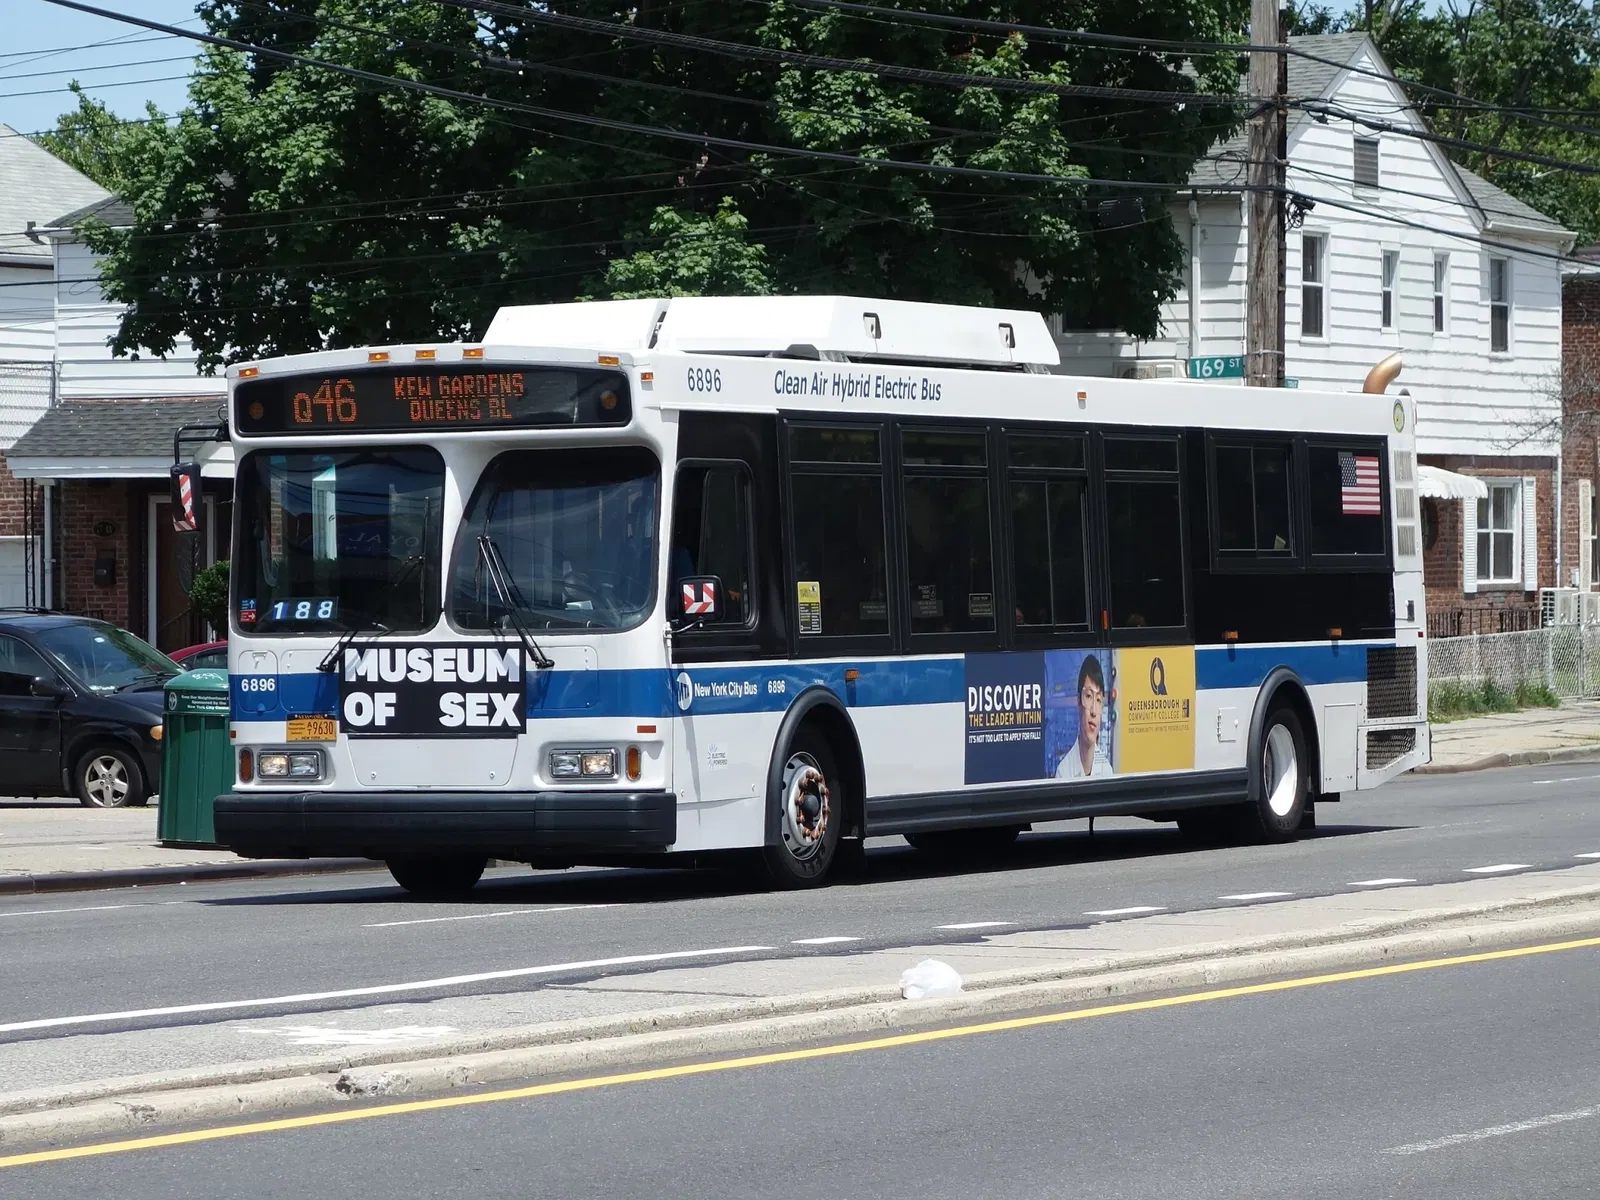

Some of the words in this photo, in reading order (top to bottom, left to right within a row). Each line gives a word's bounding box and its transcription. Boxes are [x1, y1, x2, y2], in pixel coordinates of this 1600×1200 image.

[1195, 359, 1224, 377] 169
[1229, 358, 1240, 368] ST
[687, 367, 722, 393] 6896
[774, 370, 807, 395] Clean
[811, 372, 828, 396] Air
[832, 373, 870, 402] Hybrid
[874, 375, 917, 400] Electric
[922, 378, 941, 401] Bus
[293, 379, 357, 423] Q46
[409, 399, 480, 421] QUEENS
[489, 398, 512, 419] BL
[274, 601, 333, 620] 188
[344, 648, 519, 683] MUSEUM
[241, 678, 275, 692] 6896
[694, 683, 710, 697] New
[711, 682, 728, 697] York
[729, 681, 742, 698] City
[744, 681, 757, 696] Bus
[768, 680, 785, 694] 6896
[969, 684, 1041, 712] DISCOVER
[1128, 699, 1180, 711] QUEENSBOROUGH
[344, 692, 397, 727] OF
[439, 692, 521, 727] SEX
[969, 714, 984, 727] THE
[986, 712, 1014, 726] LEADER
[1016, 711, 1041, 724] WITHIN
[1128, 711, 1157, 721] COMMUNITY
[1159, 710, 1180, 720] COLLEGE
[977, 735, 985, 743] NOT
[985, 734, 993, 743] TOO
[994, 733, 1003, 742] LATE
[1003, 733, 1009, 741] TO
[1009, 732, 1021, 741] APPLY
